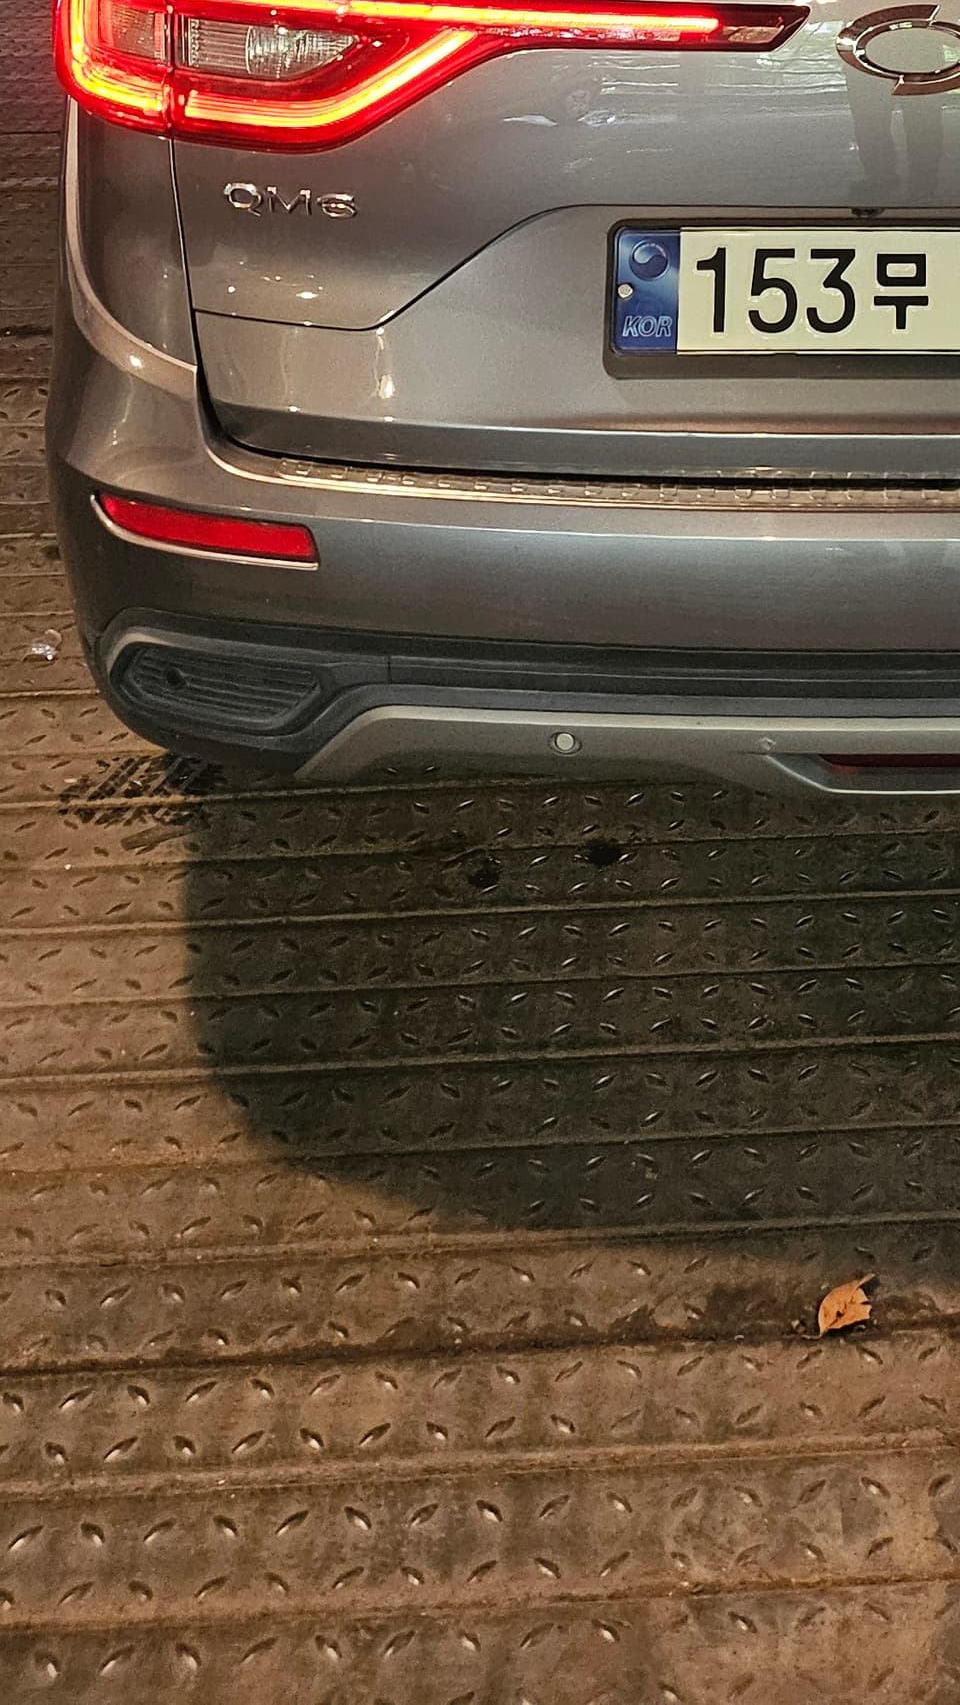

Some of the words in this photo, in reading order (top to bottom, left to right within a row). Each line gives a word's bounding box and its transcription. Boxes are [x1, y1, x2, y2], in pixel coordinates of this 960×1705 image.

[224, 182, 357, 219] QM6
[696, 247, 929, 334] 153무
[622, 315, 673, 338] KOR
